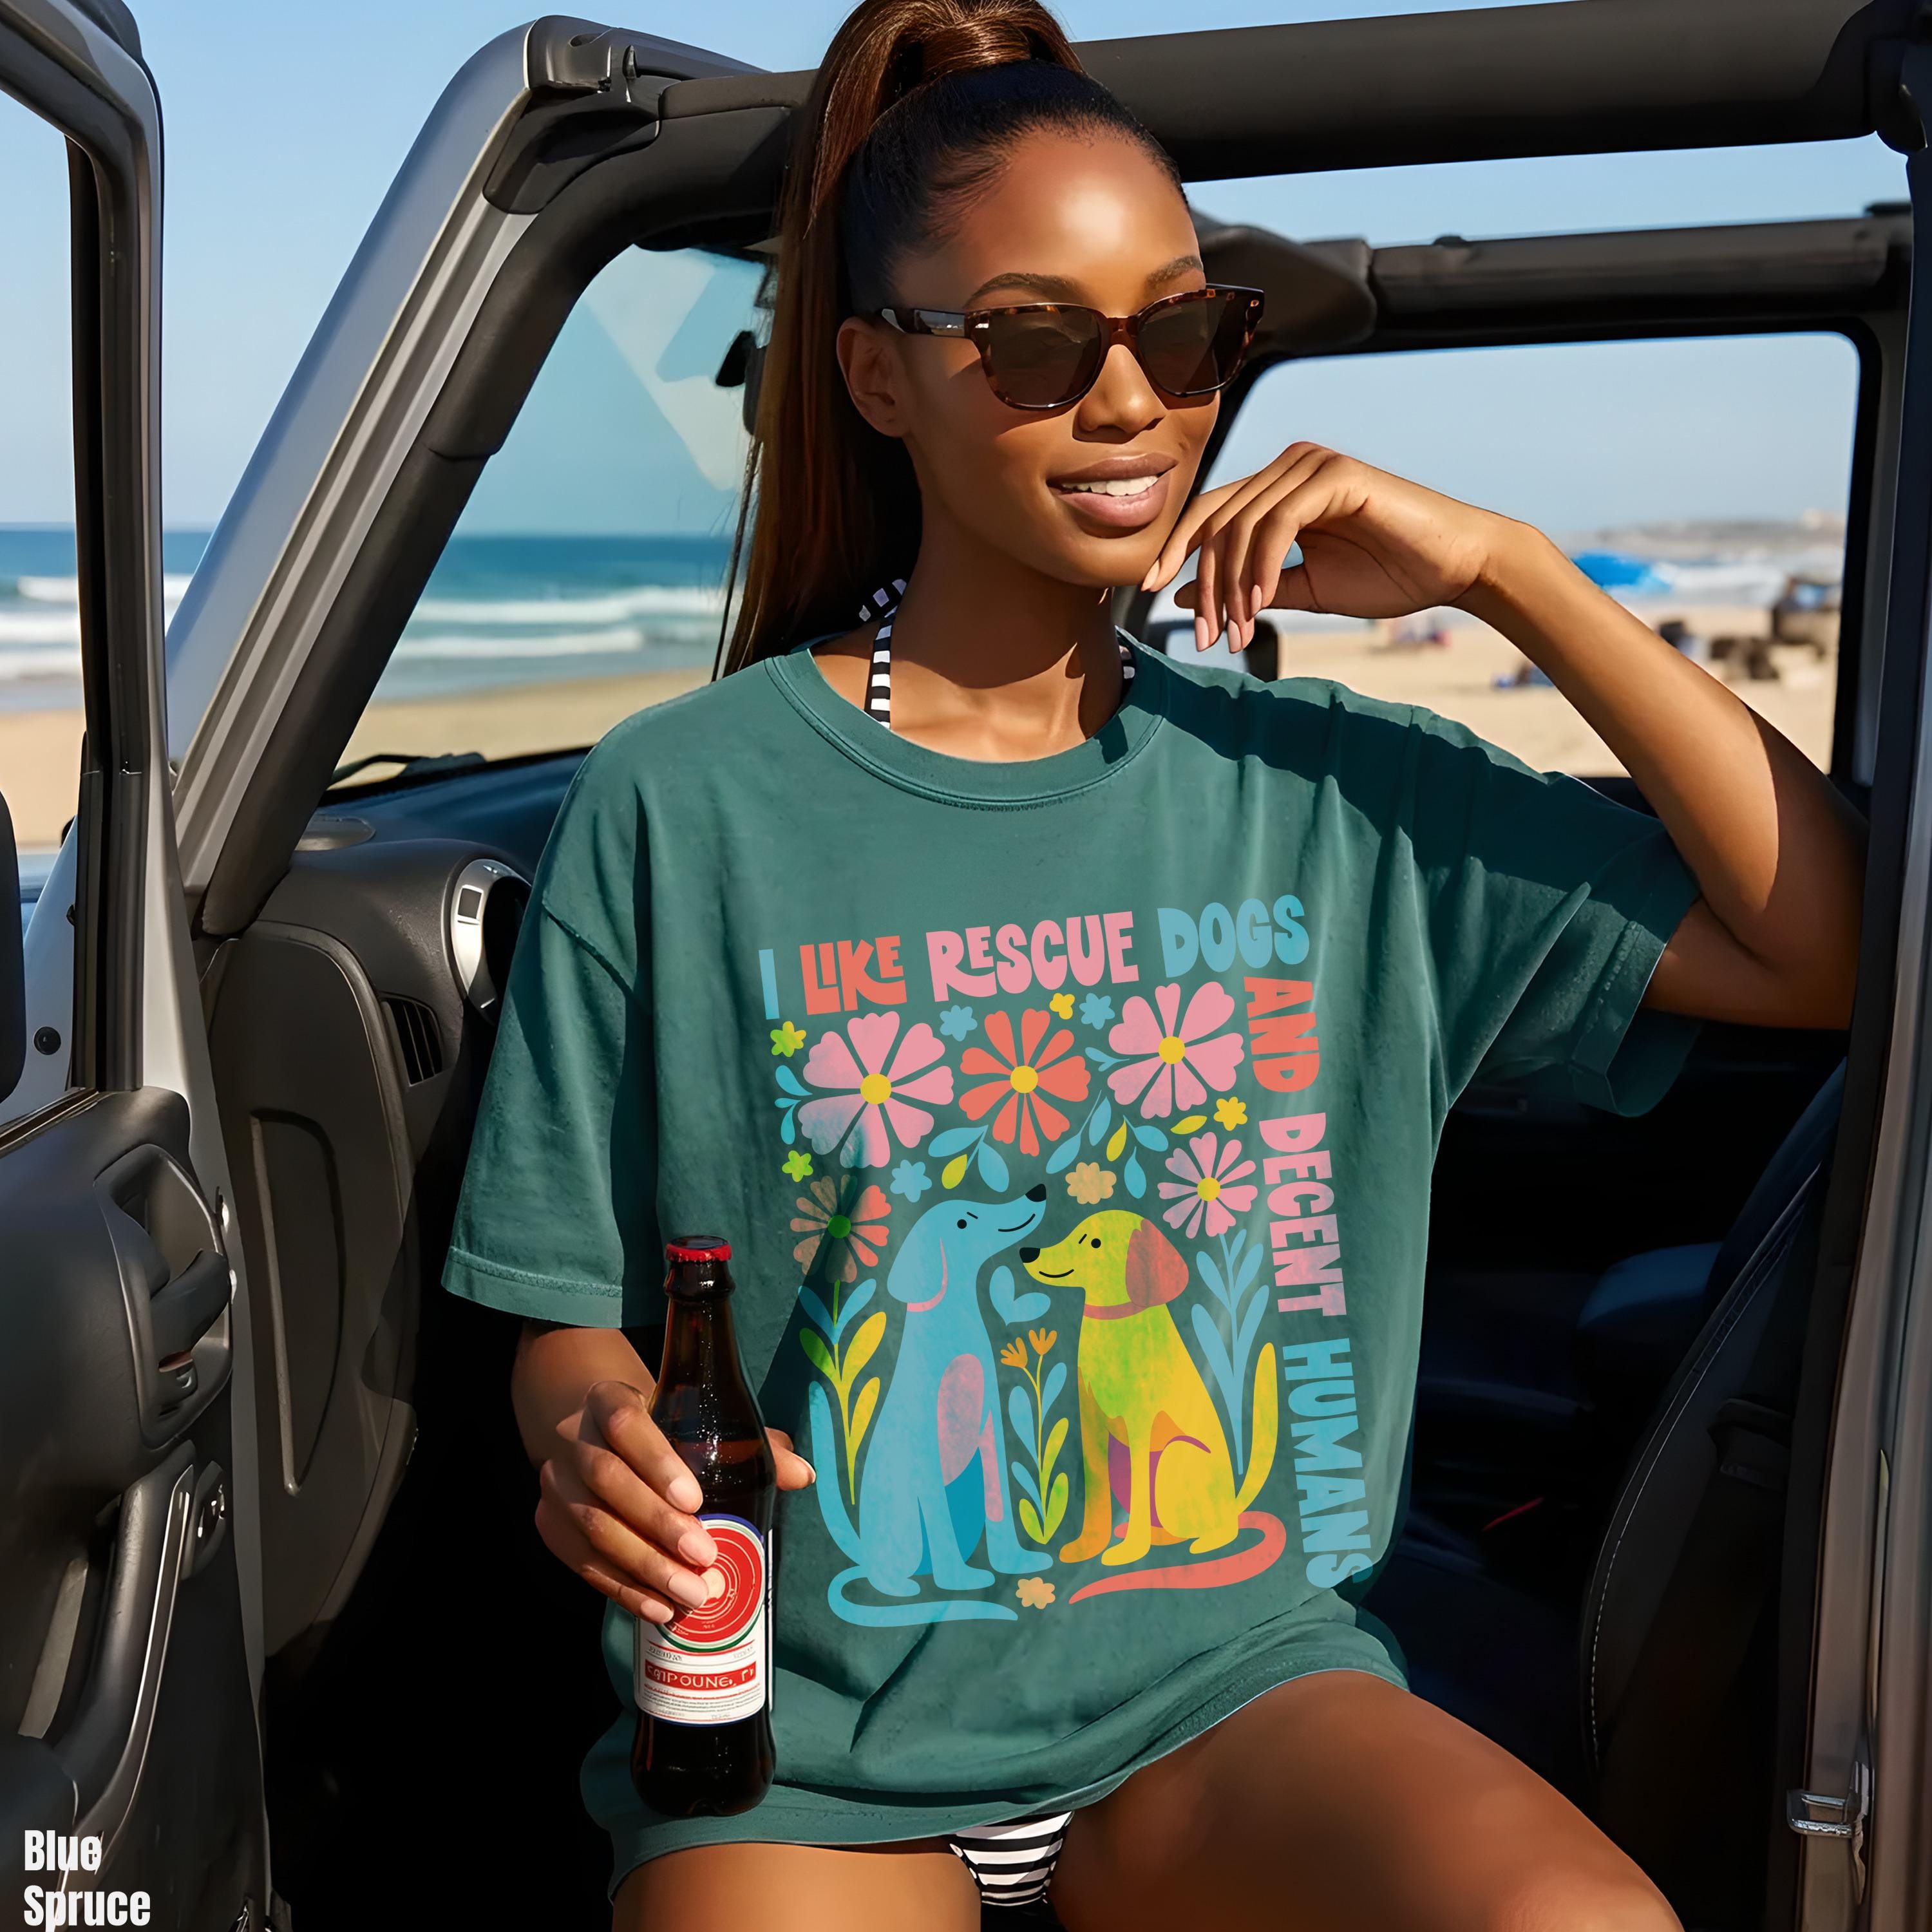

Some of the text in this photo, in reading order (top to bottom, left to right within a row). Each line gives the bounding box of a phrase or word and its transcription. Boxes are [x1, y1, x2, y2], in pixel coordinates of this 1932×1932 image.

[759, 895, 1310, 1020] I LIKE RESCUE DOGS
[1244, 976, 1374, 1589] AND DECENT HUMANS
